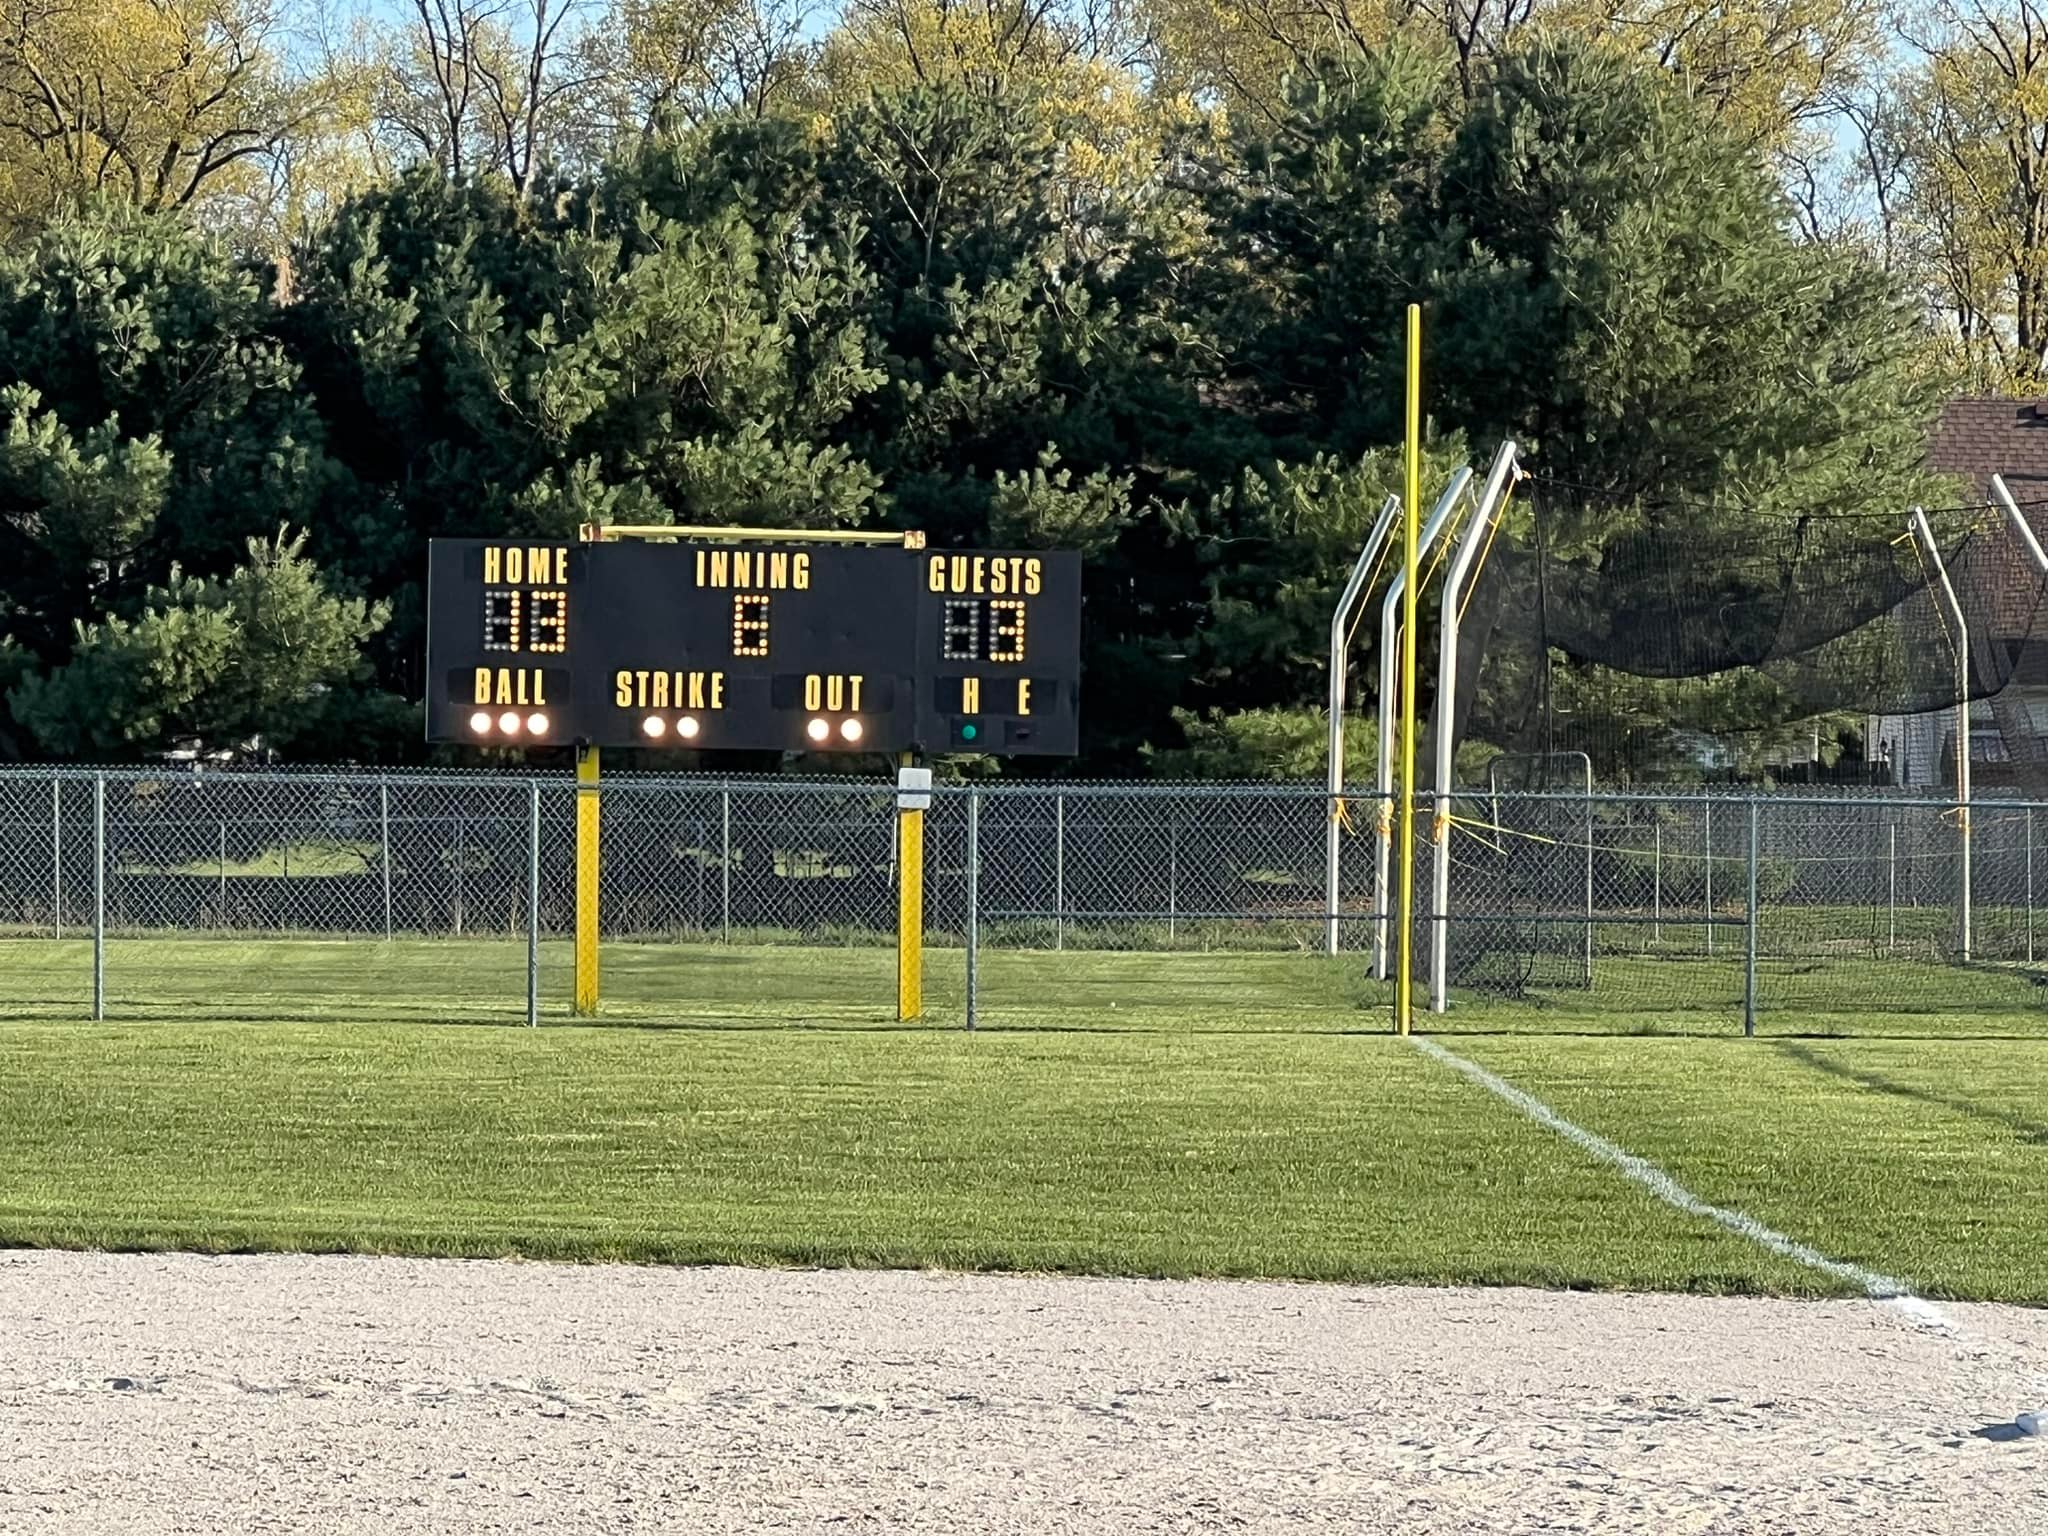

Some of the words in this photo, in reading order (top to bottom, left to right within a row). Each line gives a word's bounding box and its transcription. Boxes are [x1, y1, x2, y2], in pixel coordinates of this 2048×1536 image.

[484, 546, 568, 585] HOME
[696, 550, 810, 590] INNING
[928, 555, 1041, 595] GUESTS
[509, 590, 567, 653] 13
[733, 594, 770, 657] 6
[474, 667, 546, 708] BALL
[616, 670, 724, 709] STRIKE
[804, 674, 863, 713] OUT
[962, 677, 979, 714] H
[1018, 678, 1031, 716] E
